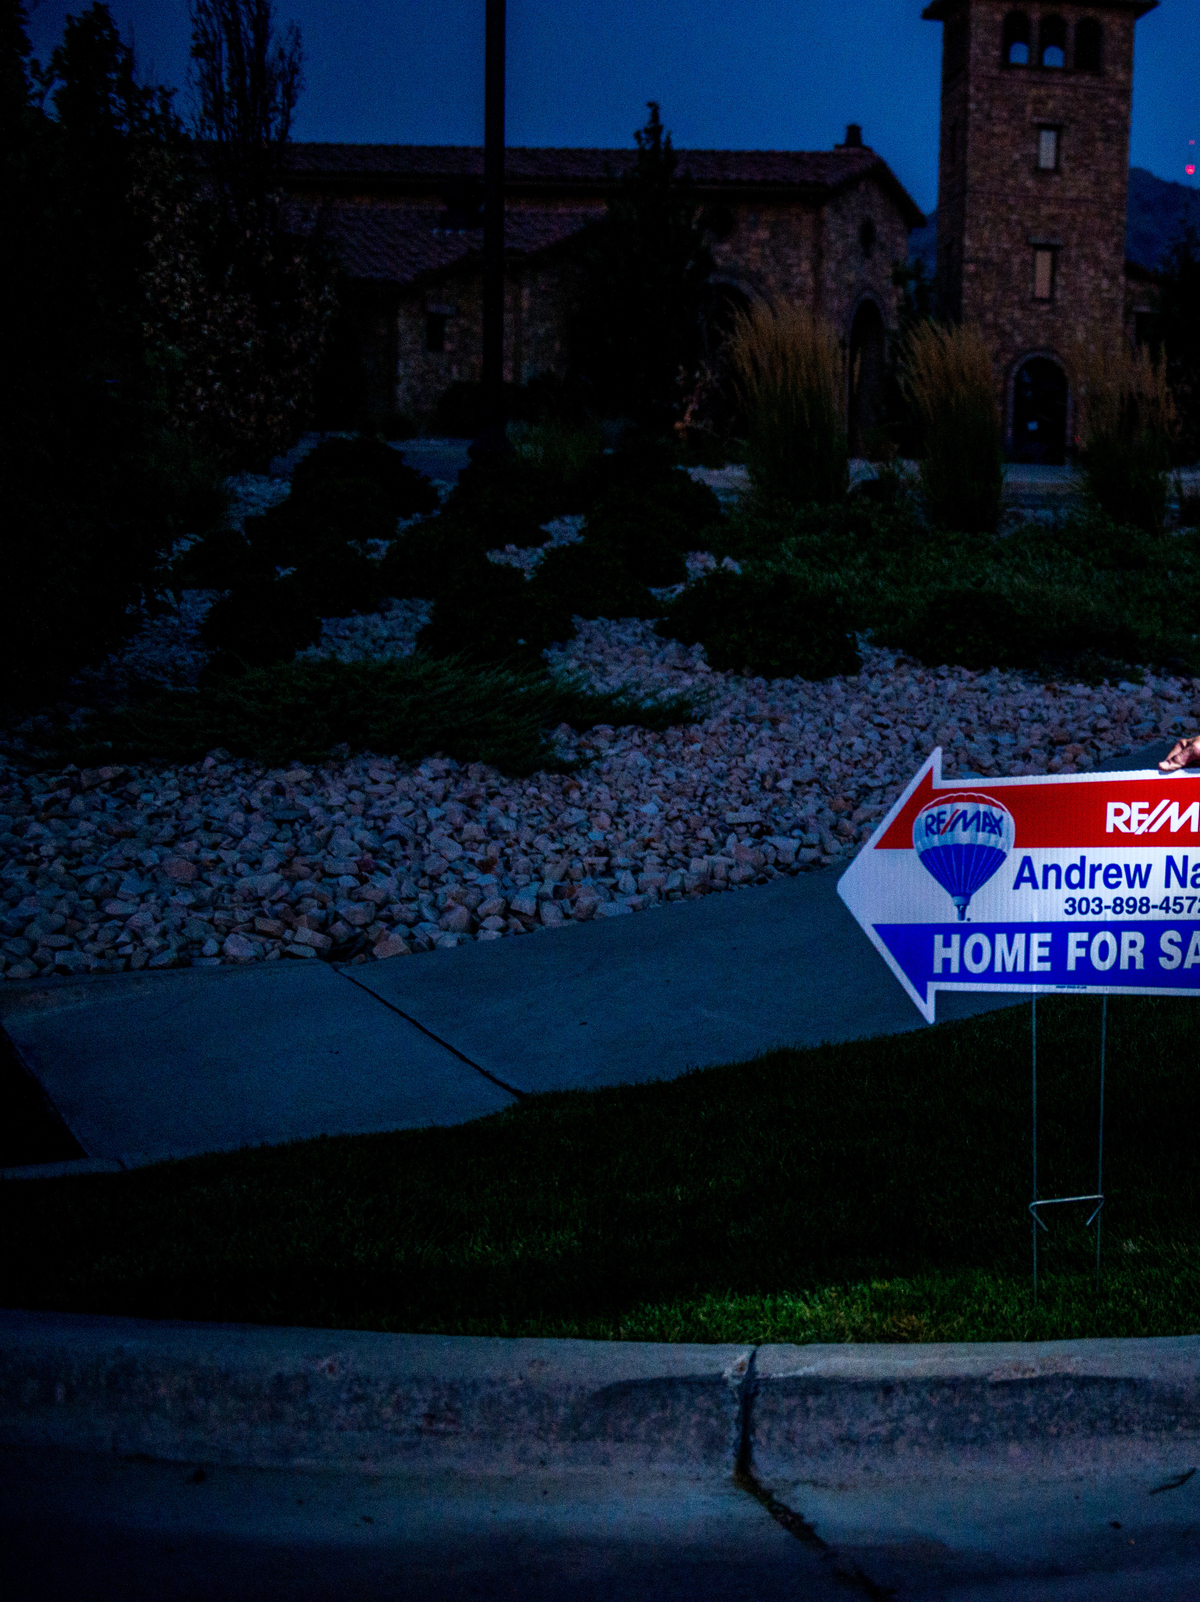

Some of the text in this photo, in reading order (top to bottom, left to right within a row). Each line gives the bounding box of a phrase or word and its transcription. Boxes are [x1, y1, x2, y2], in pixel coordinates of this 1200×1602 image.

[924, 808, 1004, 838] RE/MAX
[1012, 855, 1153, 890] Andrew
[933, 932, 1052, 974] HOME
[1066, 931, 1145, 972] FOR
